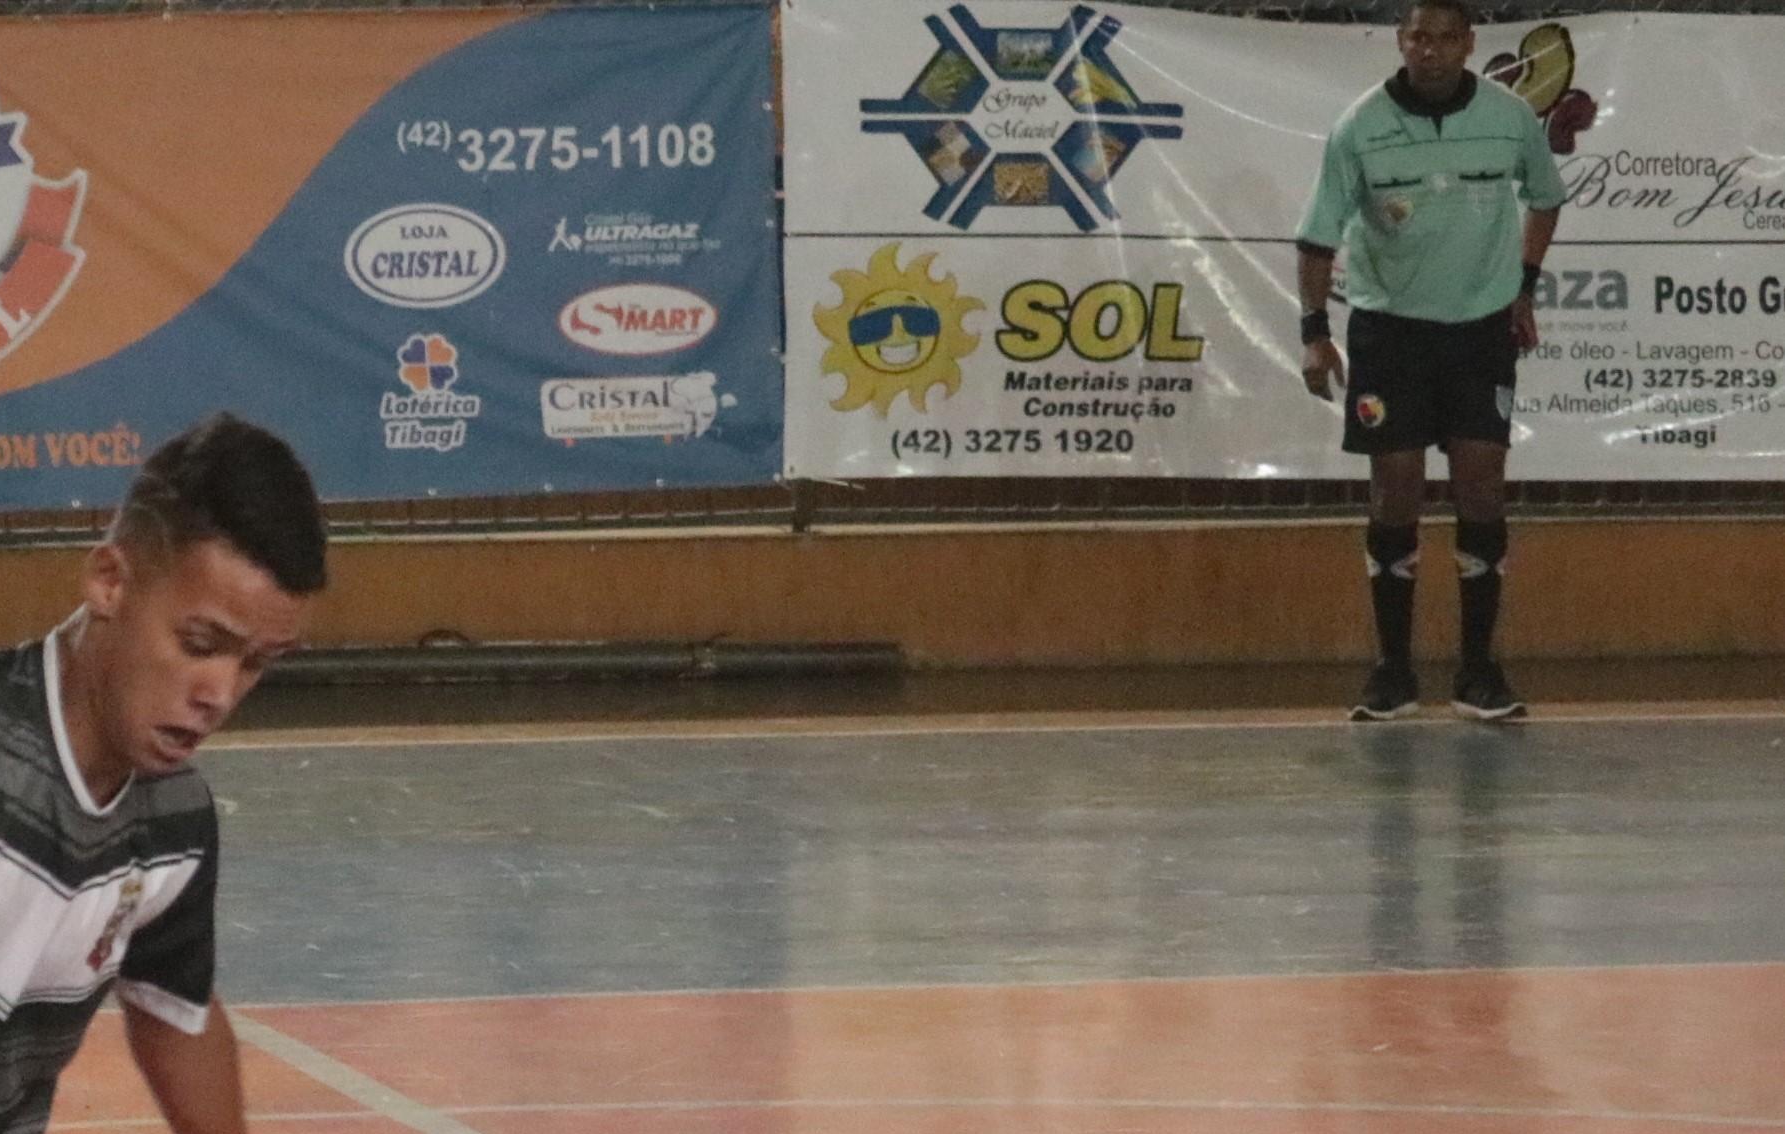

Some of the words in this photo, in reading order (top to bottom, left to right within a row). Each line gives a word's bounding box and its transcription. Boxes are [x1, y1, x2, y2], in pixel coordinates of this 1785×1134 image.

[982, 87, 1047, 114] Grupo
[397, 120, 451, 154] (42)
[457, 122, 716, 173] 3275-1108
[1615, 150, 1719, 178] Corretora
[1558, 153, 1679, 209] Bom
[1673, 155, 1785, 229] Jesu
[399, 225, 448, 241] LOJA
[585, 222, 701, 242] ULTRAGAZ
[1742, 210, 1785, 231] Cerea
[371, 248, 481, 280] CRISTAL
[1654, 275, 1747, 314] Posto
[994, 278, 1206, 363] SOL
[1536, 341, 1563, 360] de
[1570, 340, 1615, 361] óleo
[1637, 340, 1734, 365] Lavagem
[1004, 371, 1130, 391] Materiais
[1138, 373, 1194, 397] para
[1584, 369, 1634, 392] (42)
[1642, 367, 1777, 389] 3275-2839
[382, 393, 478, 416] Lotérica
[1023, 396, 1177, 423] Construção
[1518, 400, 1542, 414] ua
[1547, 394, 1633, 415] Almeida
[385, 425, 464, 447] Tibagi
[891, 428, 953, 459] (42)
[965, 428, 1042, 453] 3275
[1055, 428, 1135, 453] 1920
